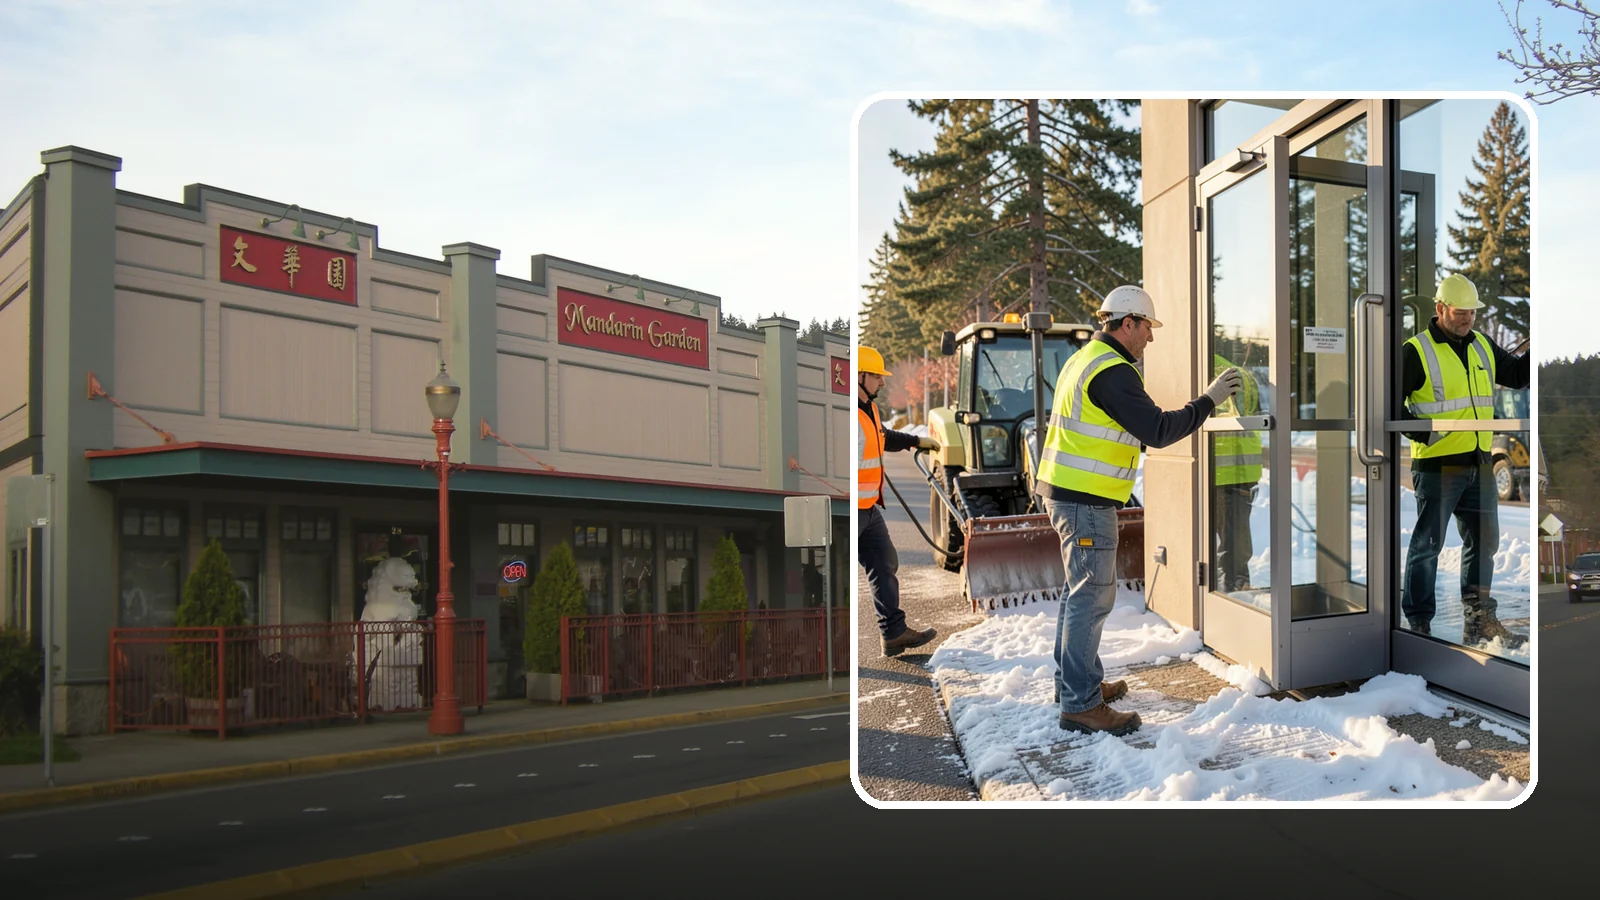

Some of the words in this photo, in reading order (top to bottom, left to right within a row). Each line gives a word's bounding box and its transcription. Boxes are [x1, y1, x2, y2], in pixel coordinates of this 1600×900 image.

[564, 302, 644, 341] Mandarin
[648, 320, 701, 352] Garden
[503, 565, 527, 578] OPEN
